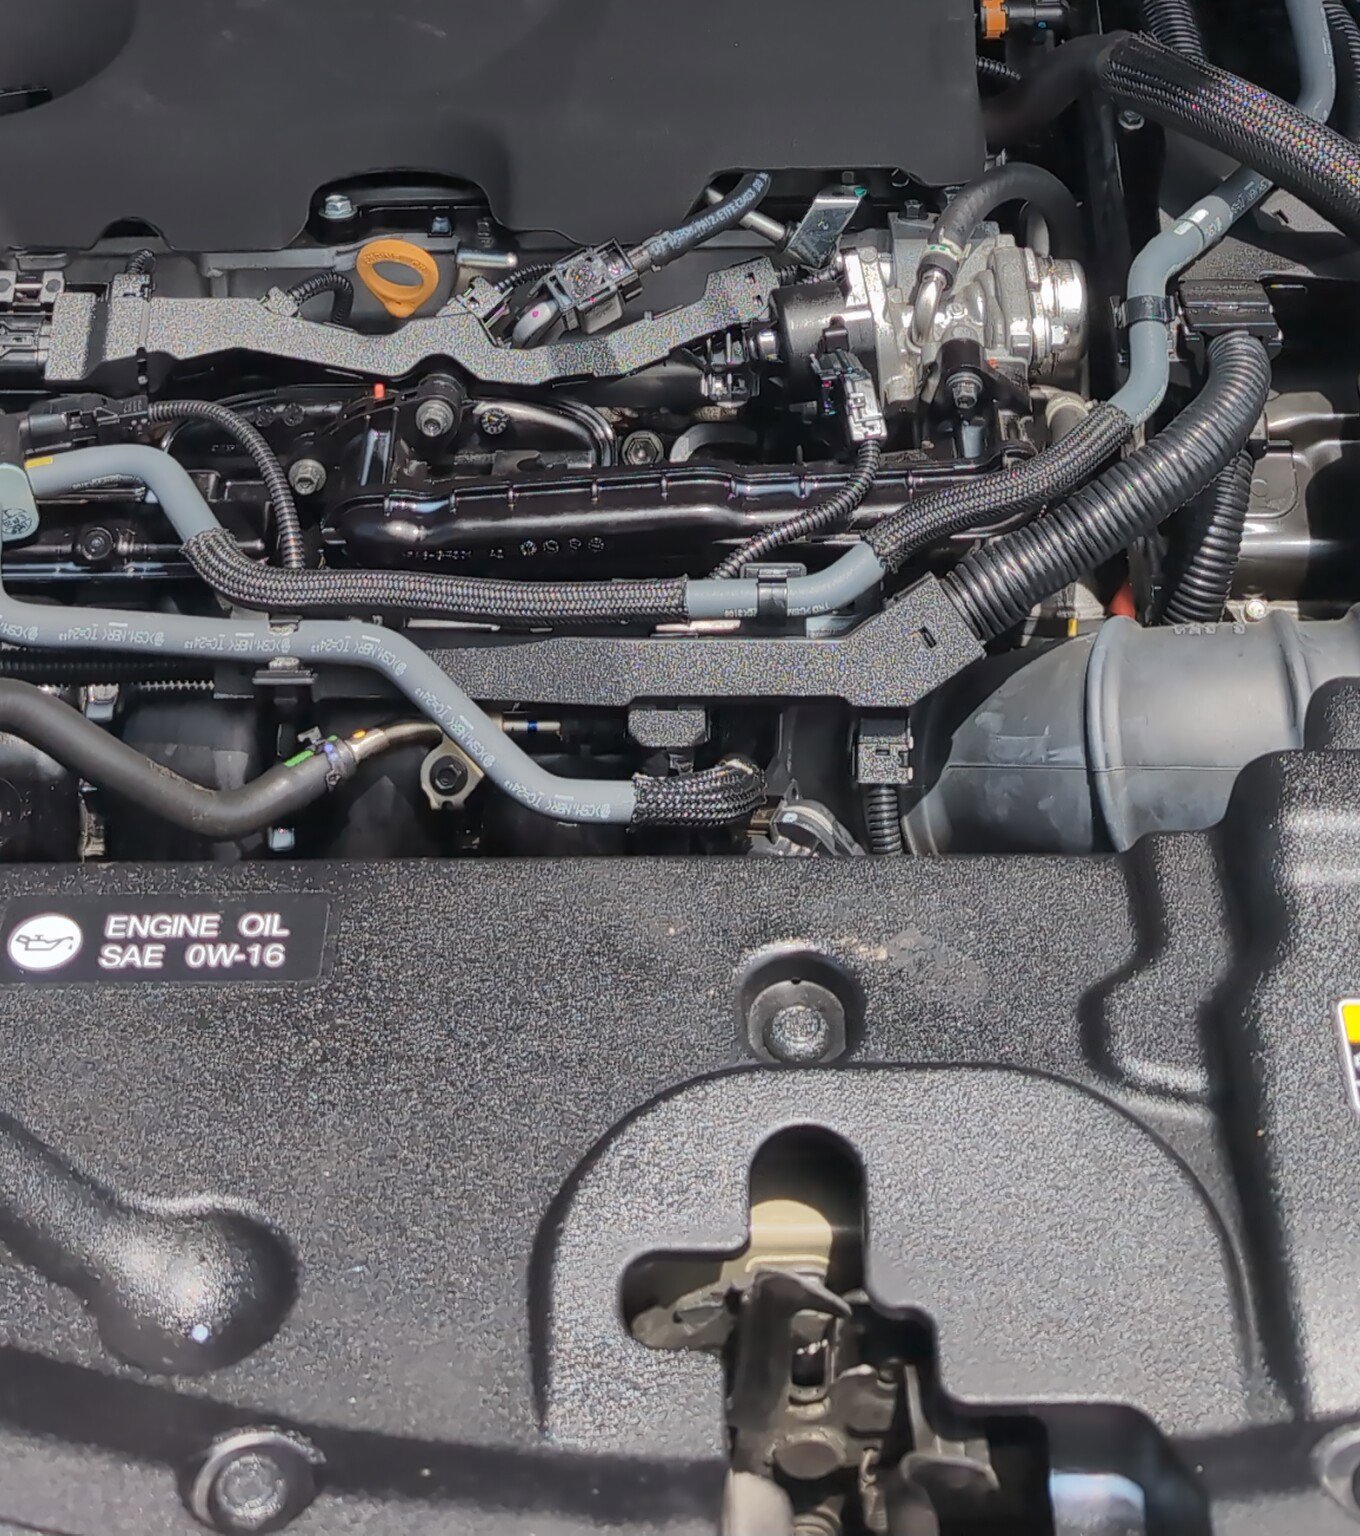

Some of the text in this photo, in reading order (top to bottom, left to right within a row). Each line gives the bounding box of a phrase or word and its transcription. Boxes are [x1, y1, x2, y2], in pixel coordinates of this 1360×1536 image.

[104, 912, 290, 938] ENGINE OIL
[98, 943, 286, 968] SAE 0W-16
